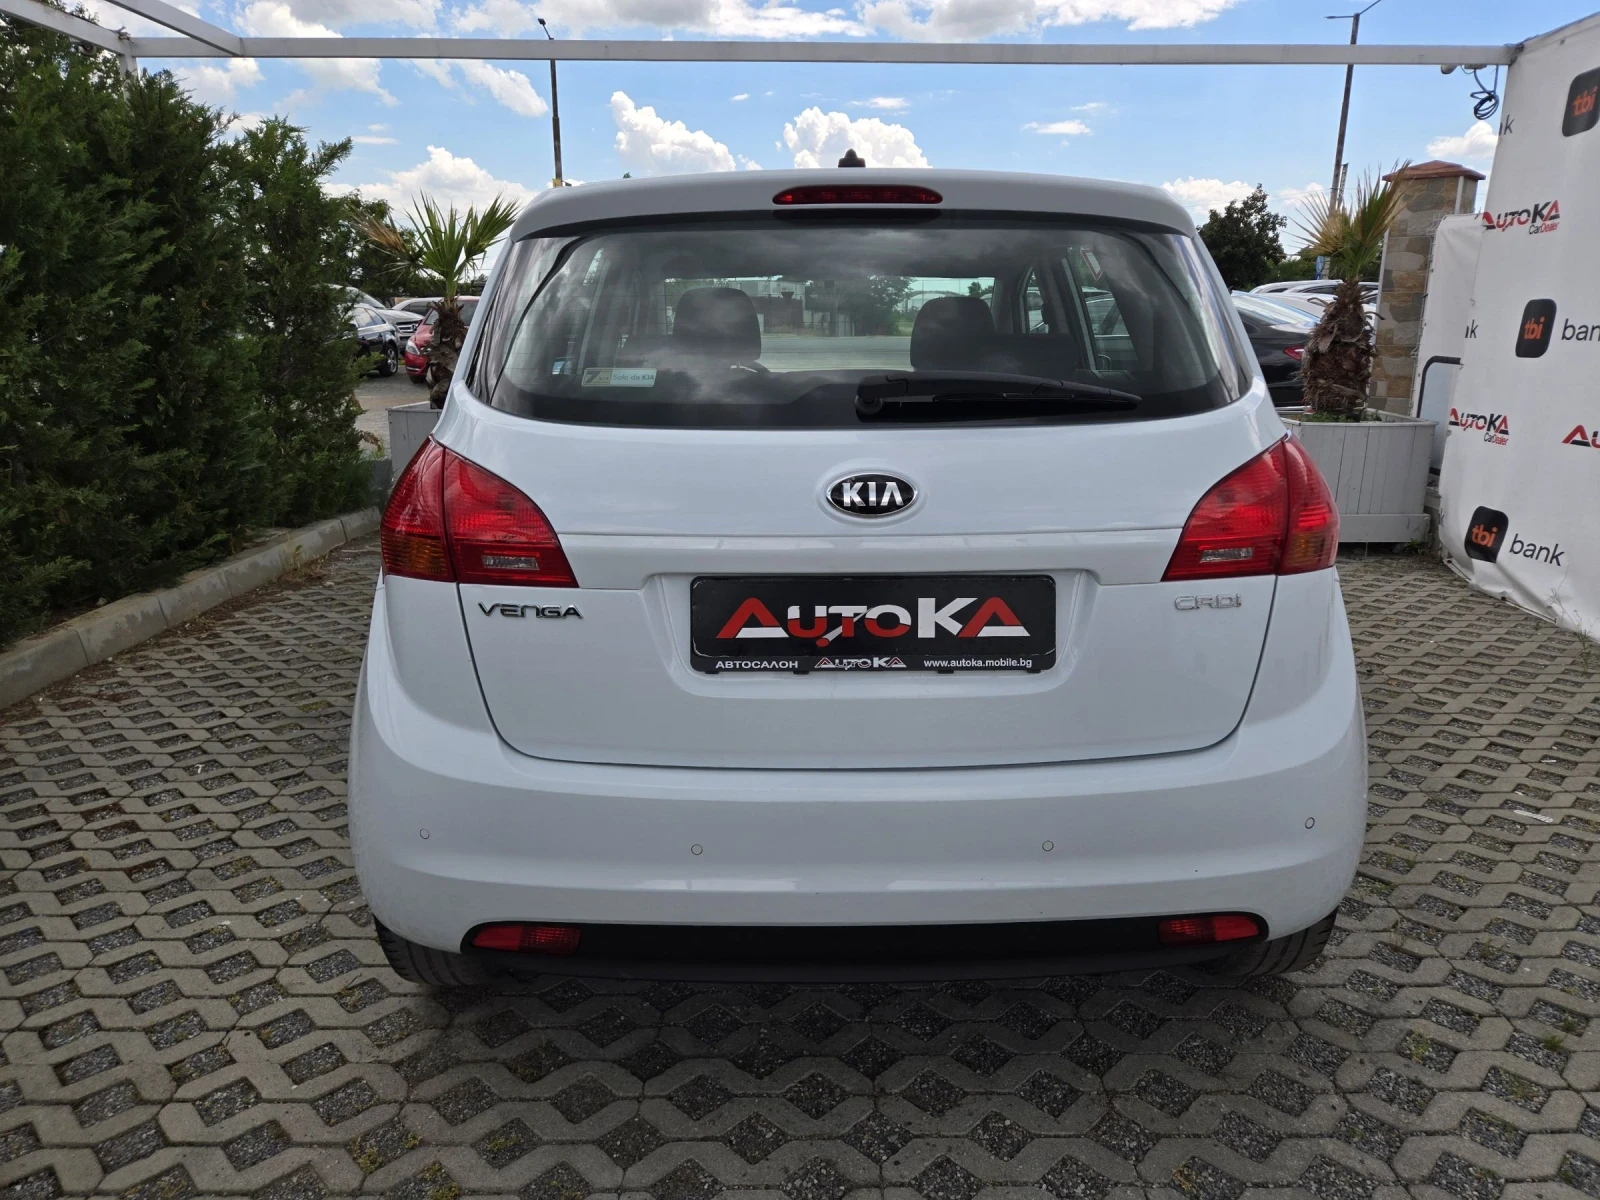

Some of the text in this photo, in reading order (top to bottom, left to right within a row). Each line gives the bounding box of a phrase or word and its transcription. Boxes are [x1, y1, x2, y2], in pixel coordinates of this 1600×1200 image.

[1573, 86, 1598, 116] tbi
[1524, 316, 1545, 340] tbi
[842, 481, 904, 507] KIA
[1471, 524, 1565, 566] tbi bank
[478, 602, 583, 619] VENGA
[715, 660, 799, 669] АВТОСАЛОН
[923, 657, 1032, 669] www.autoka.mobile.bg
